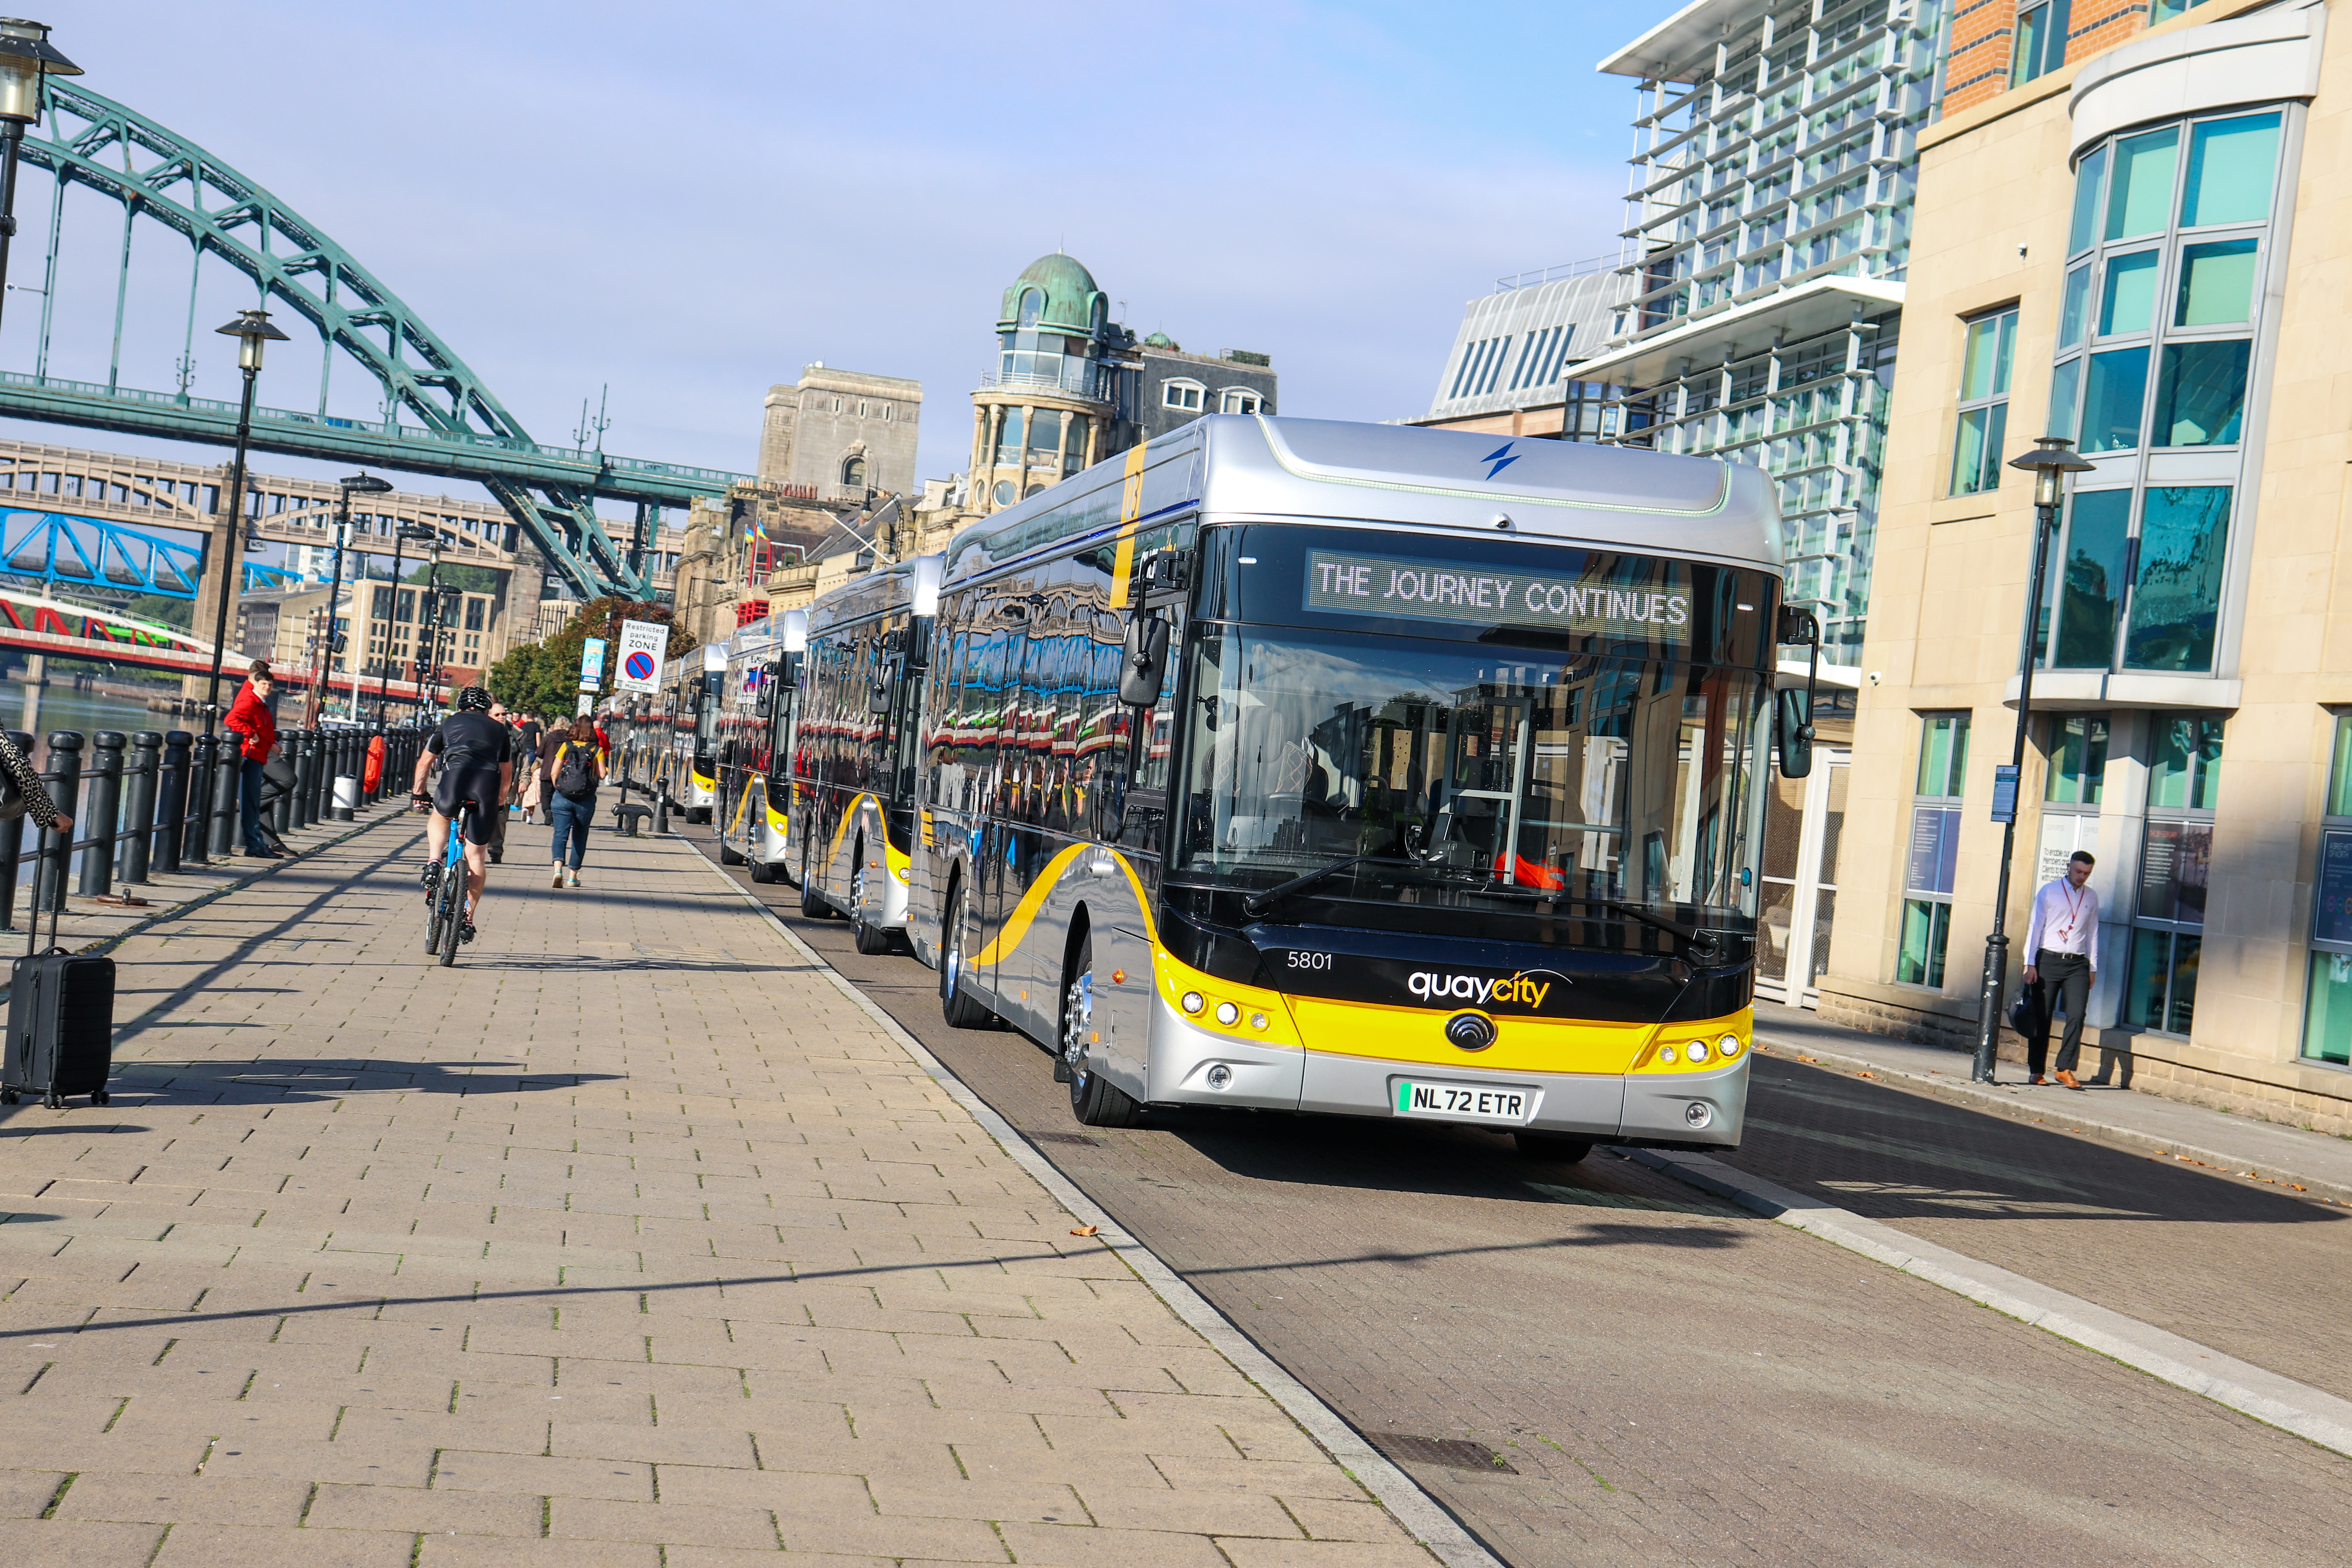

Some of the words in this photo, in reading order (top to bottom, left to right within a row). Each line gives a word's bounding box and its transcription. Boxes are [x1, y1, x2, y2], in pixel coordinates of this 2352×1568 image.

[1318, 562, 1372, 597] THE
[1383, 569, 1514, 610] JOURNEY
[1525, 582, 1689, 624] CONTINUES
[626, 622, 665, 634] Restricted
[630, 632, 658, 642] parking
[628, 639, 657, 651] ZONE
[2049, 849, 2063, 857] enable
[2043, 856, 2061, 865] Members
[2042, 865, 2055, 874] Clients
[2042, 873, 2050, 881] with
[1287, 950, 1332, 971] 5801
[1407, 970, 1550, 1009] quaycity
[1478, 1093, 1521, 1116] ETR
